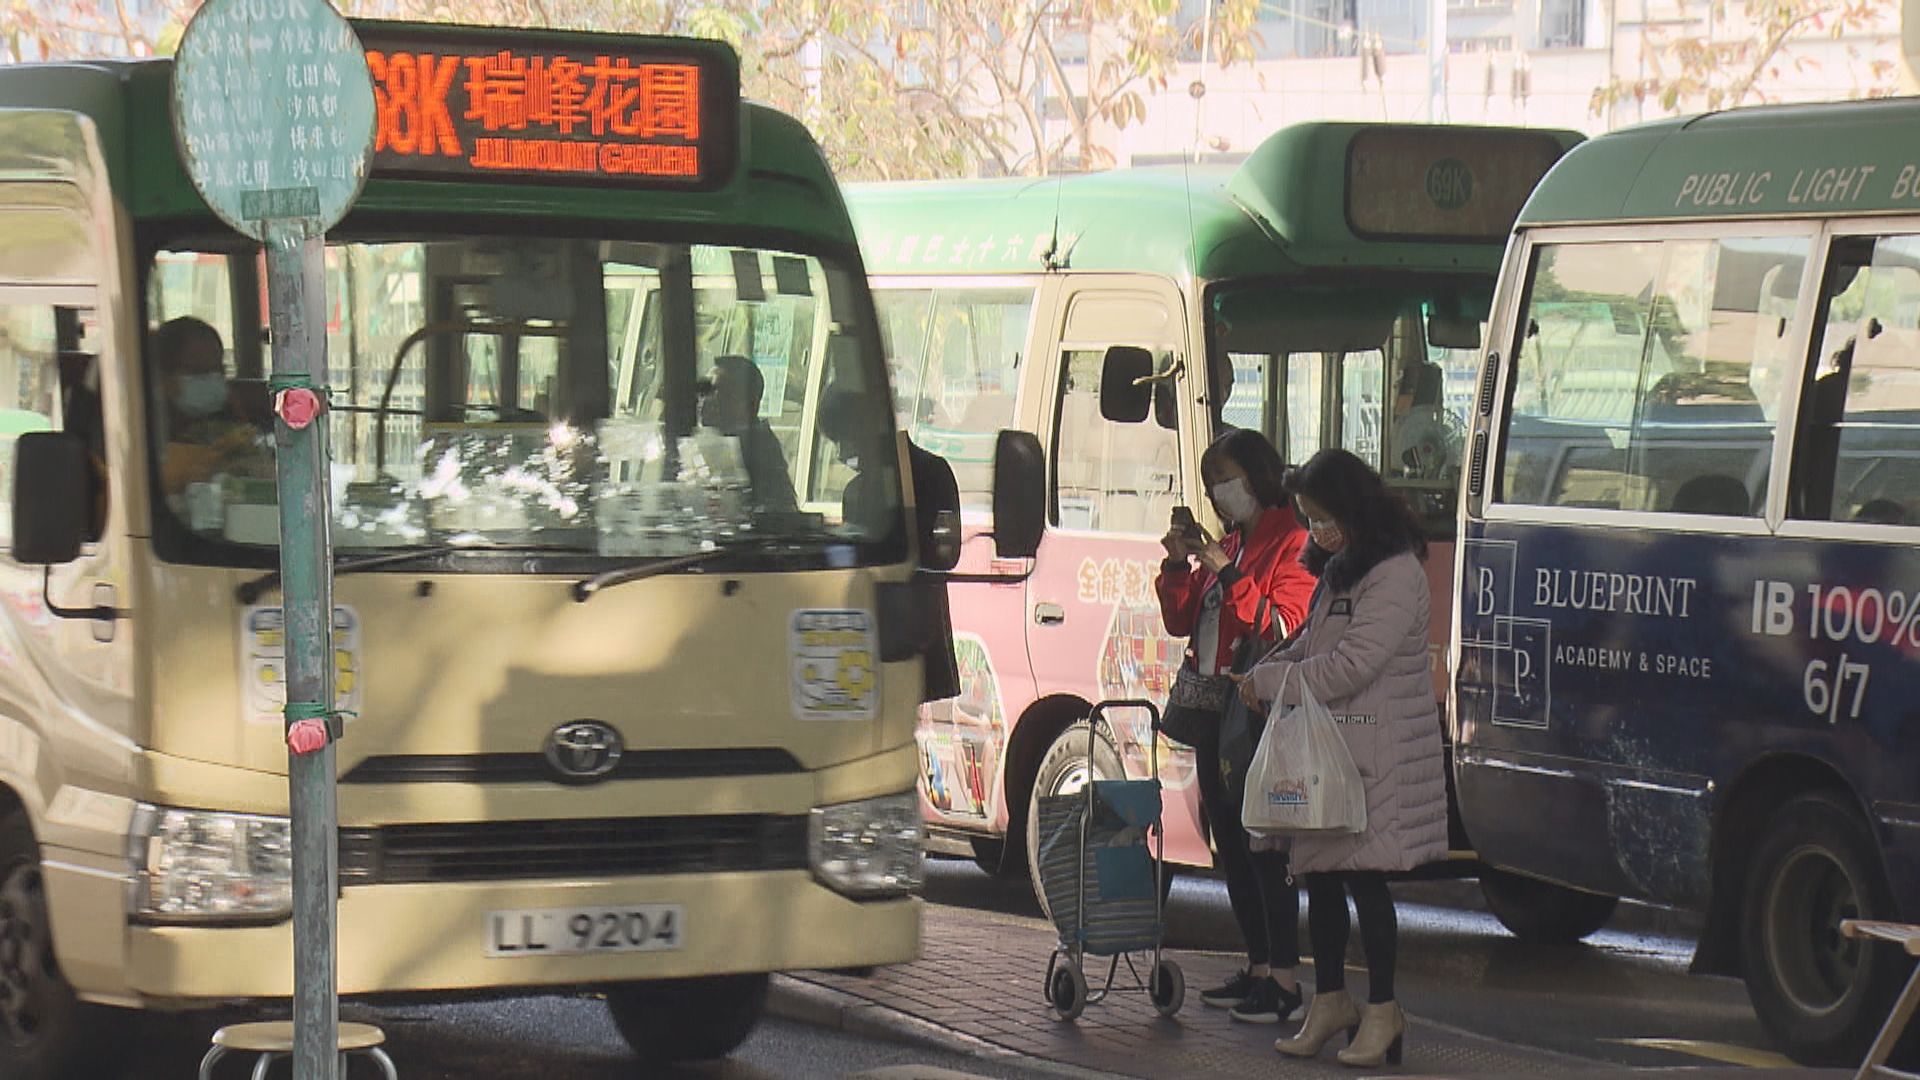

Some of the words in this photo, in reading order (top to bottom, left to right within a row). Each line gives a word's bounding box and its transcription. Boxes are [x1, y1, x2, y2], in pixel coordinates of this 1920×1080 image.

[463, 49, 700, 140] 瑞峰花園
[1675, 171, 1773, 207] PUBLIC
[1787, 165, 1875, 203] LIGHT
[1476, 567, 1495, 616] B
[1534, 568, 1696, 618] BLUEPRINT
[1752, 580, 1795, 636] IB
[1807, 584, 1920, 648] 100%
[1555, 645, 1631, 671] ACADEMY
[1639, 654, 1648, 672] &
[1656, 655, 1711, 678] SPACE
[1803, 653, 1869, 723] 6/7
[494, 915, 548, 951] LL
[568, 910, 675, 948] 9204
